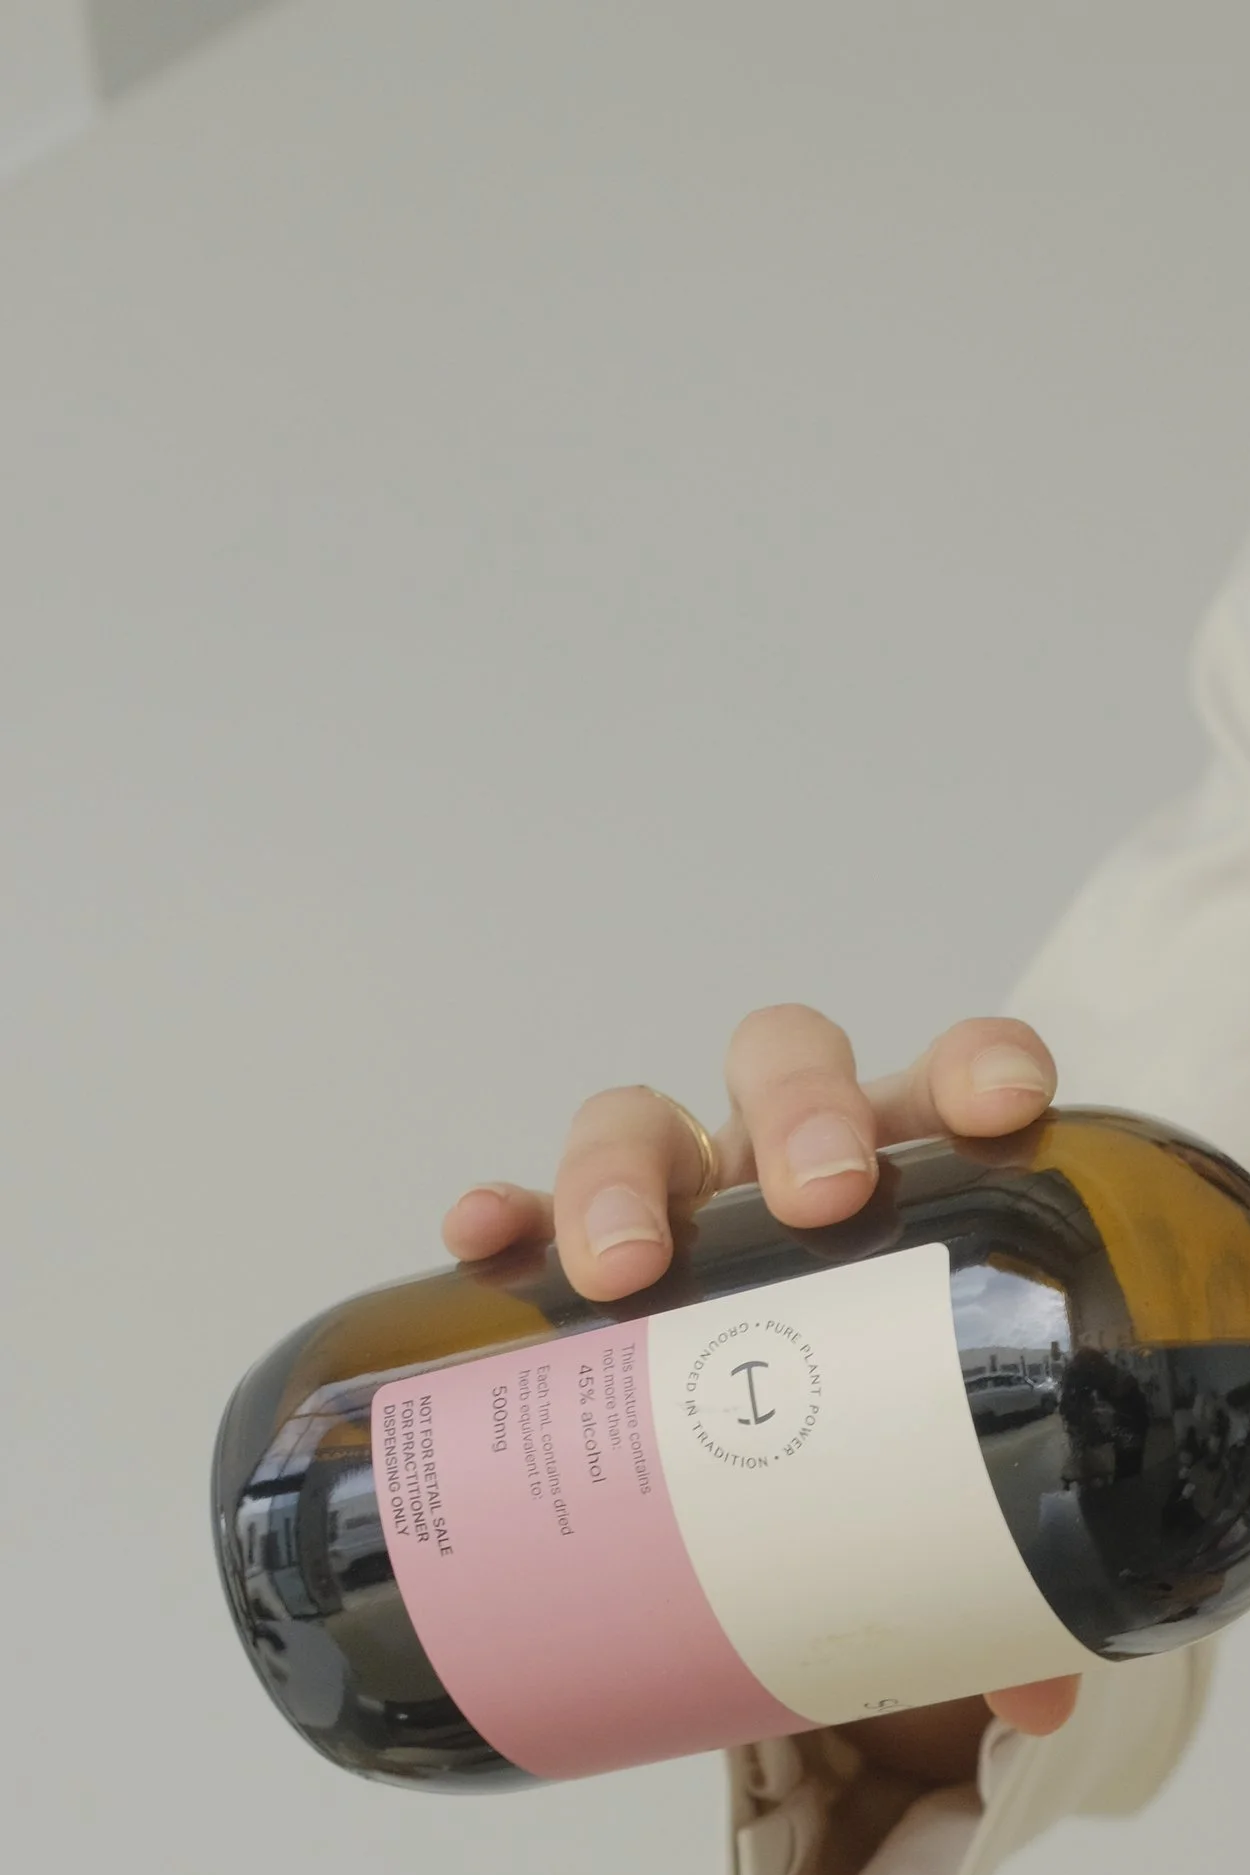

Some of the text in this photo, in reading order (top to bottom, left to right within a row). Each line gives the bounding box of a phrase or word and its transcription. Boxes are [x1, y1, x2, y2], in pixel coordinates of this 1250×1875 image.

[492, 1385, 508, 1453] 500mg
[519, 1369, 532, 1401] herb
[536, 1364, 550, 1397] Each
[578, 1364, 606, 1484] 45% alcohol
[603, 1348, 622, 1450] not more than:
[622, 1342, 652, 1495] This mixture contains
[686, 1322, 768, 1469] GROUNDED IN TRADITION
[766, 1320, 821, 1456] PURE PLANT POWER
[384, 1405, 409, 1536] DISPENSING ONLY
[401, 1400, 429, 1543] FOR PRACTITIONER
[420, 1395, 454, 1556] NOT FOR RETAIL SALE
[519, 1404, 539, 1478] equivalent
[542, 1433, 563, 1497] contains
[553, 1498, 574, 1536] dried
